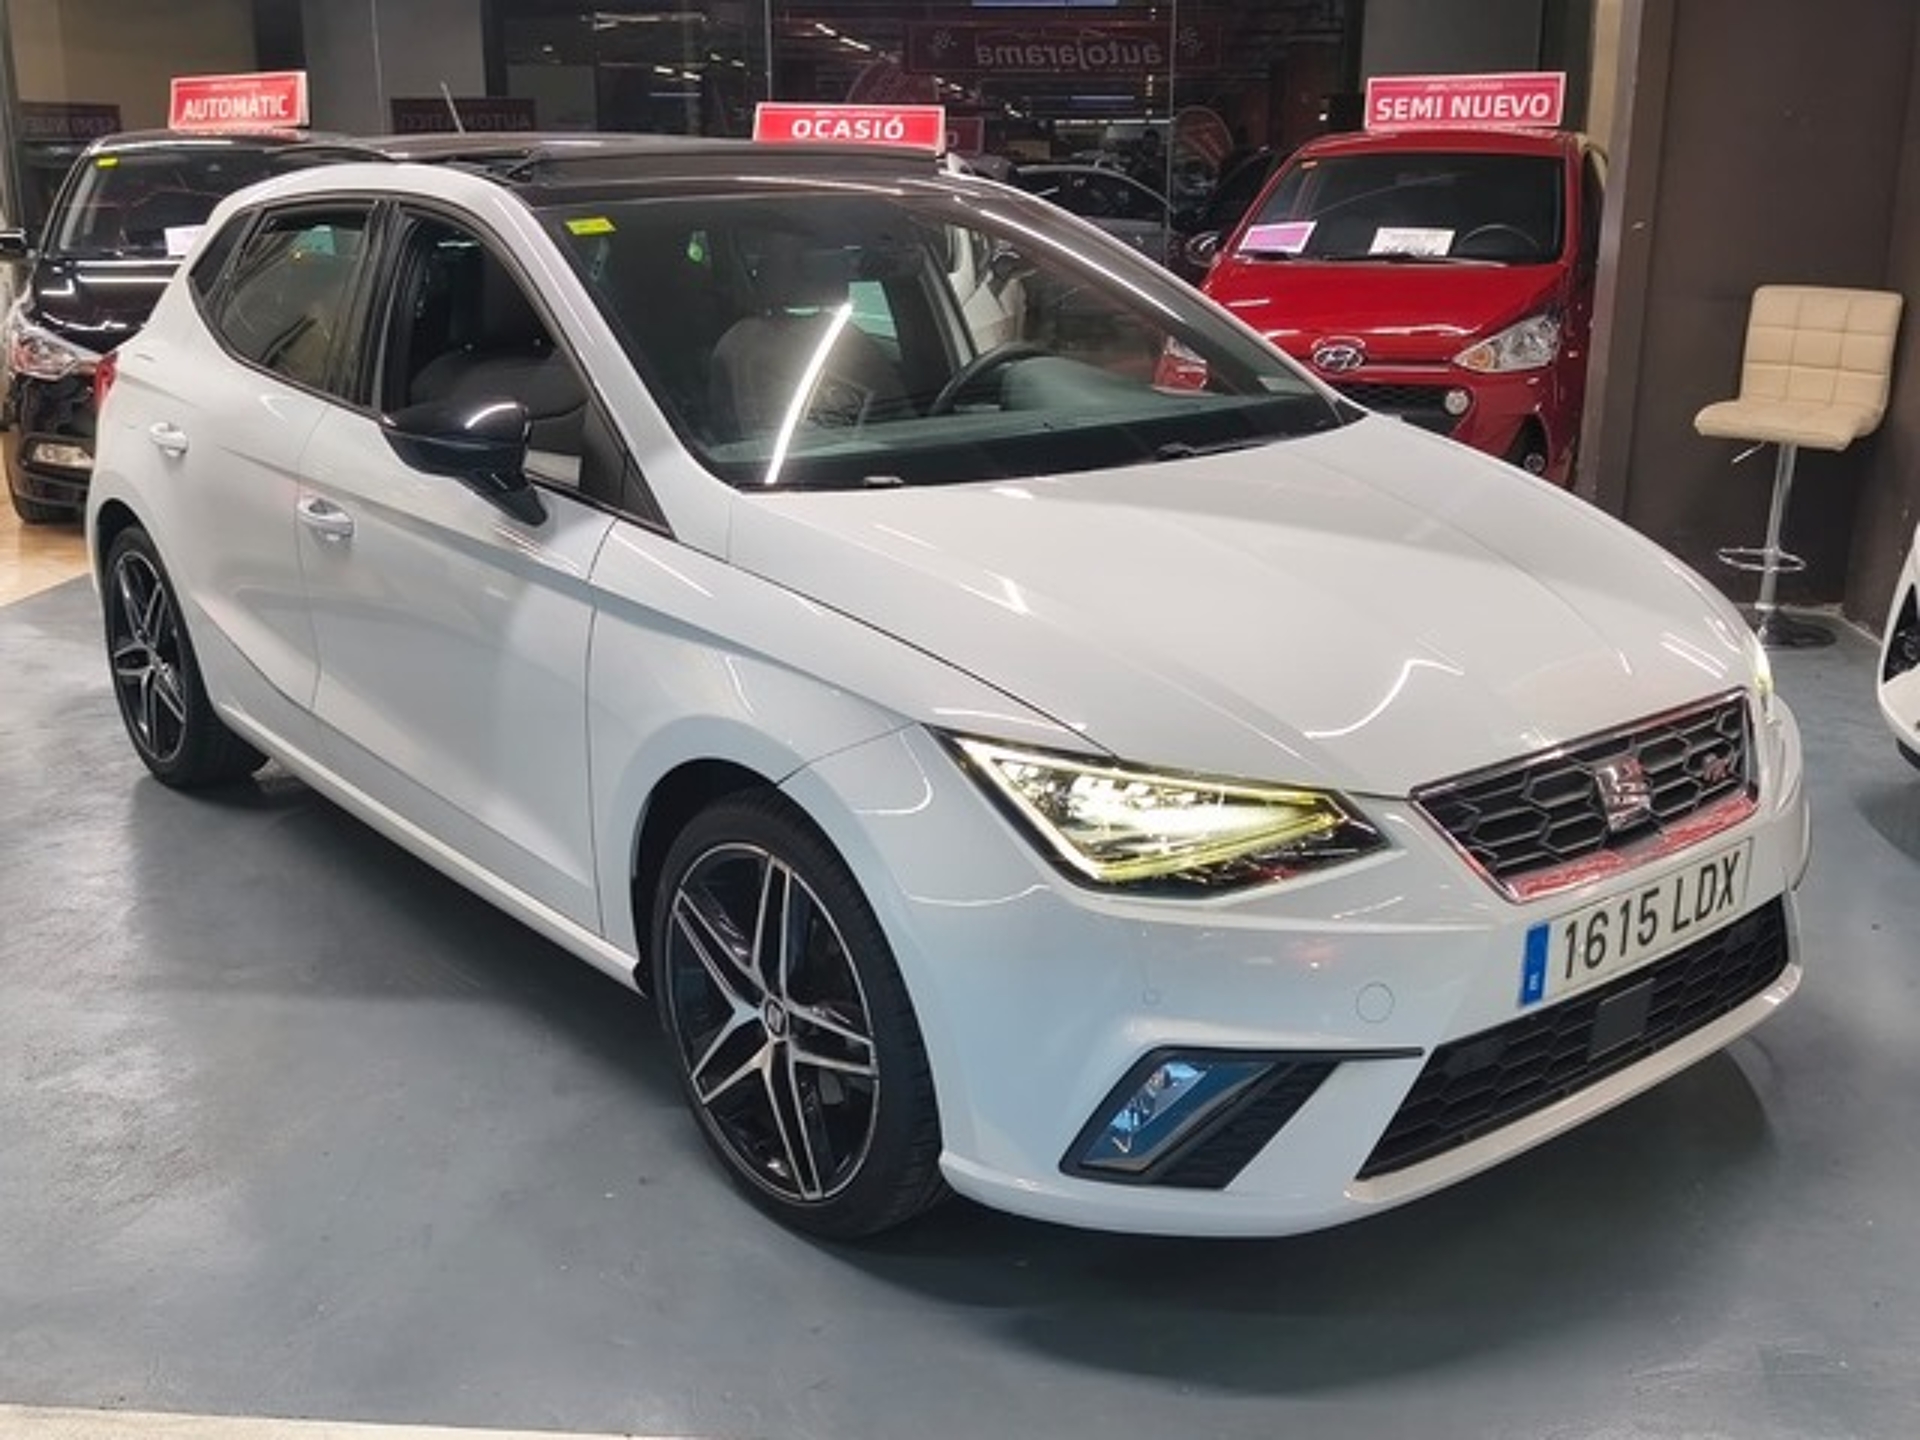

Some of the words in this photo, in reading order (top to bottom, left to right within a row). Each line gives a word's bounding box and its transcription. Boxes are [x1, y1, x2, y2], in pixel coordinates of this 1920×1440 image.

[1376, 96, 1441, 121] SEMI
[1451, 93, 1549, 118] NUEVO
[791, 115, 904, 139] OCASIÓ
[1565, 888, 1660, 979] 1615
[1671, 851, 1741, 933] LDX
